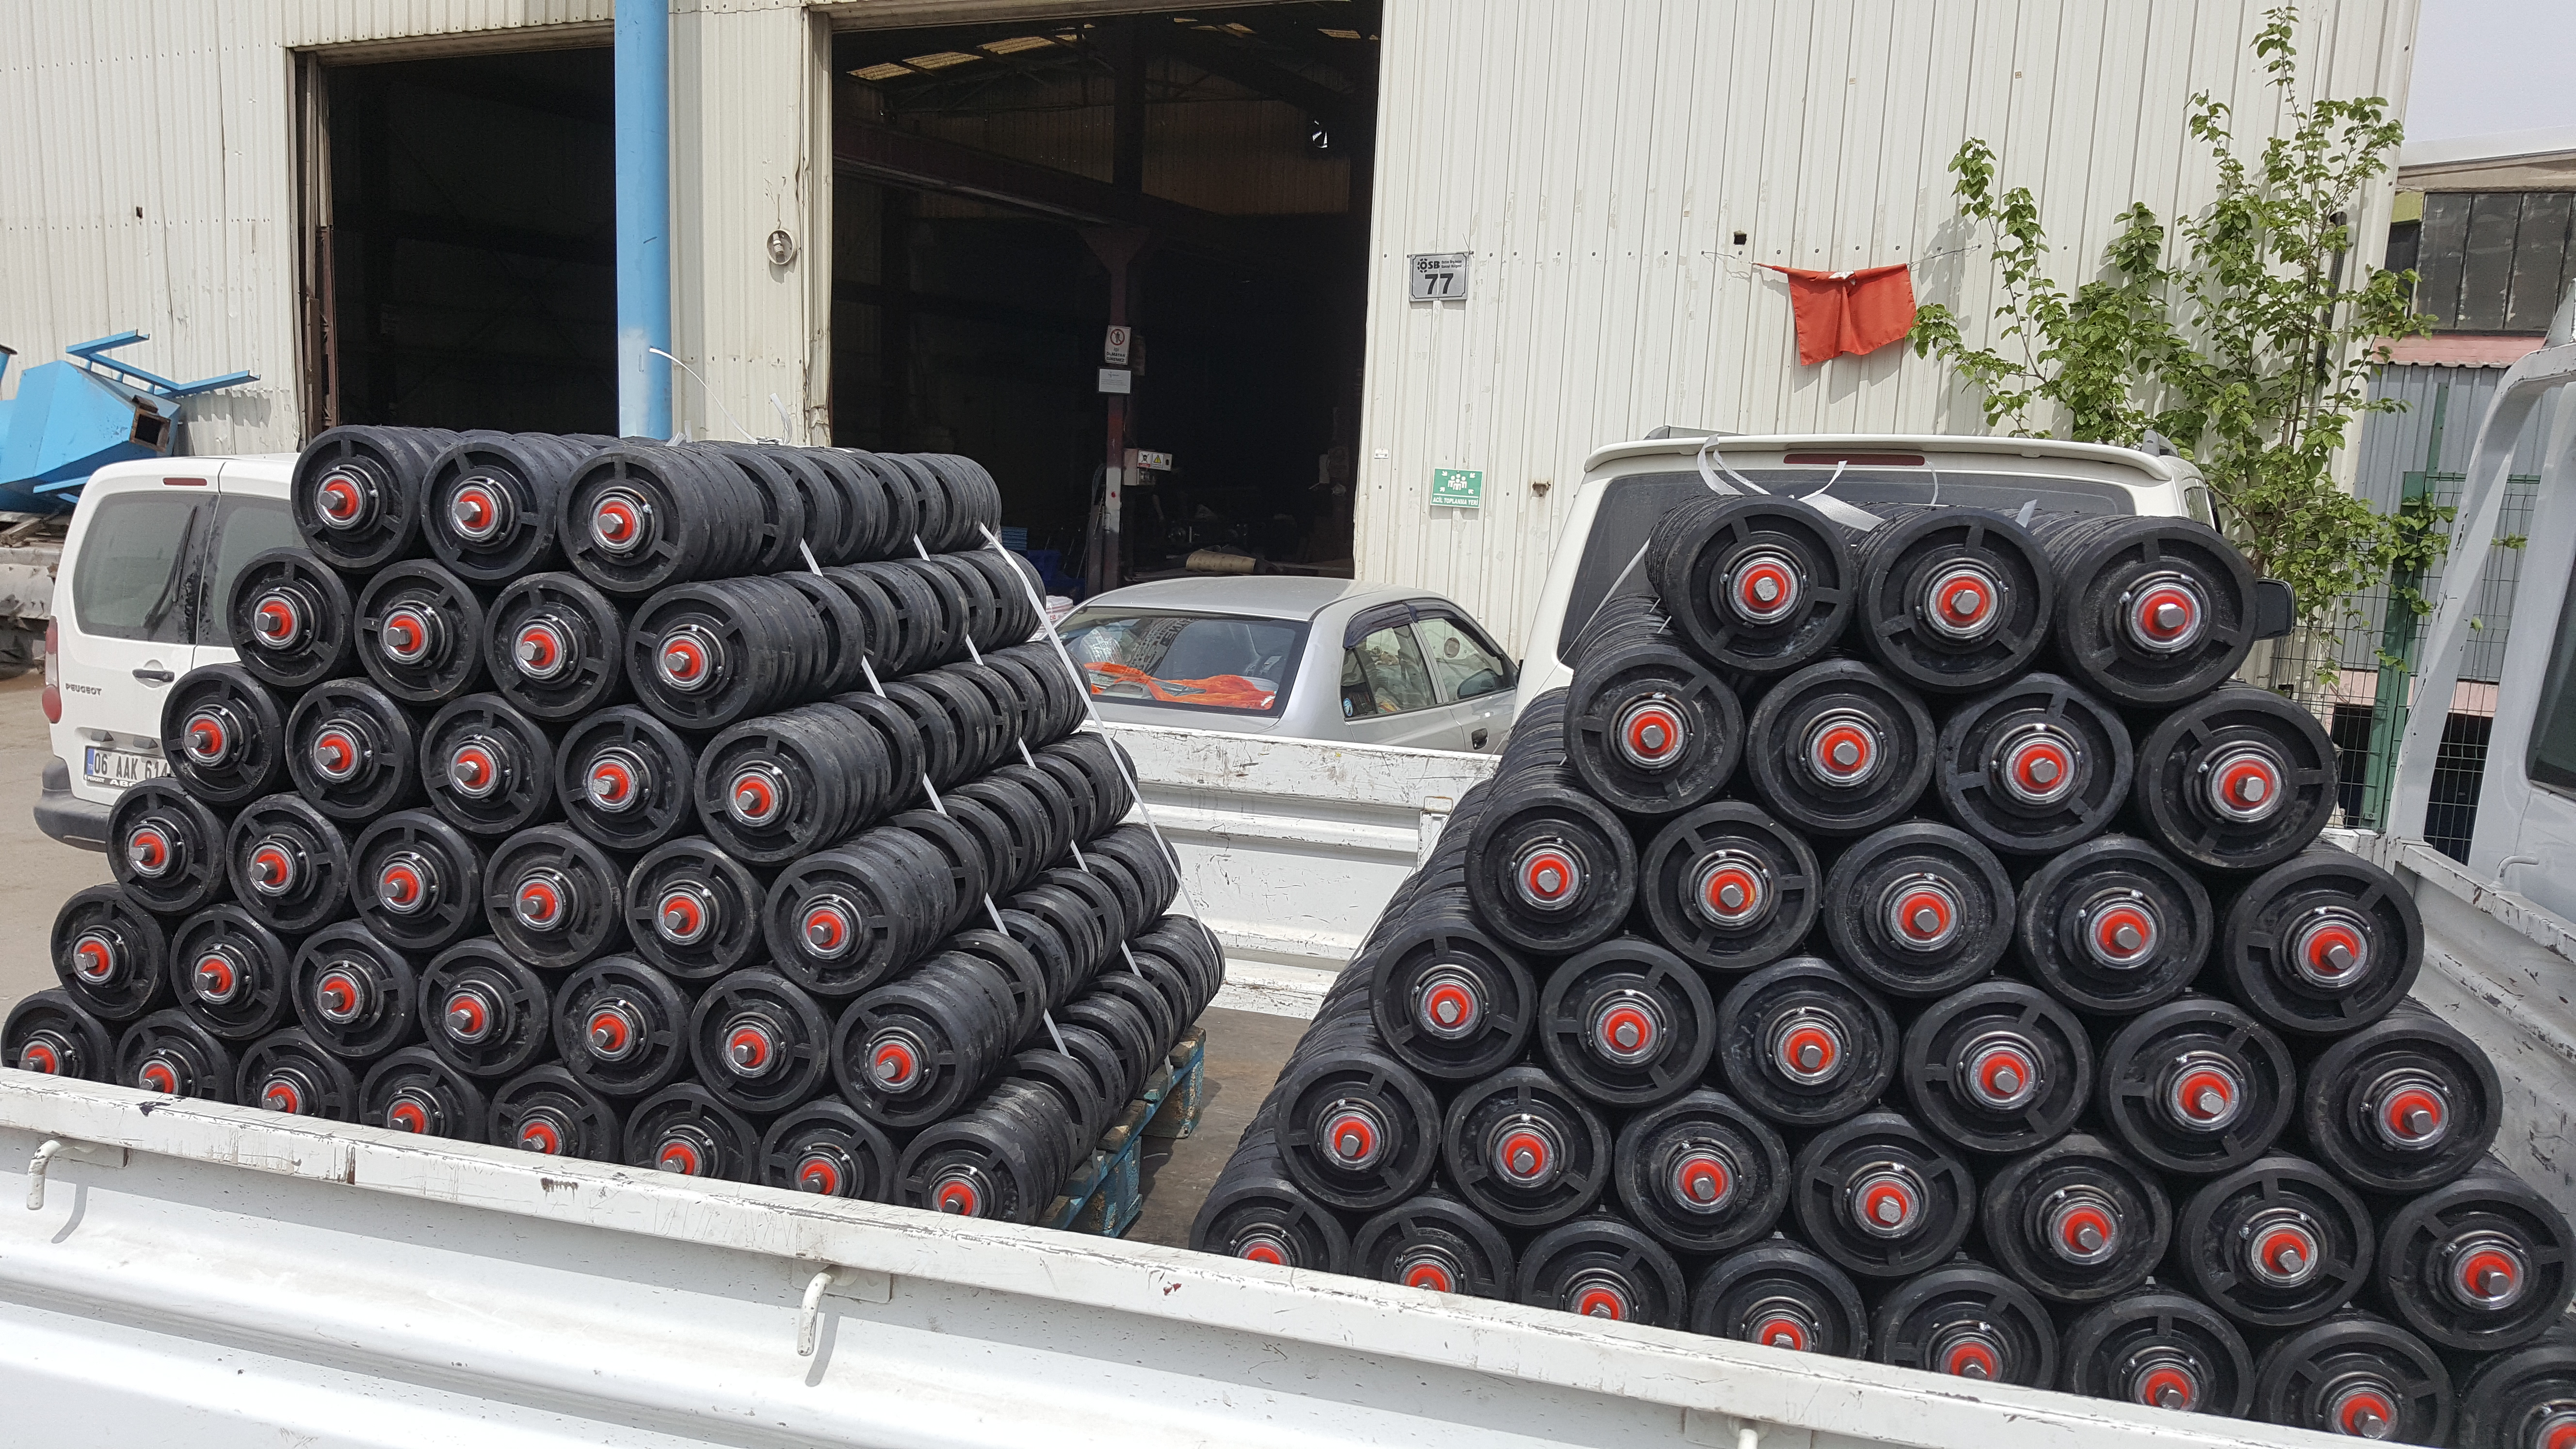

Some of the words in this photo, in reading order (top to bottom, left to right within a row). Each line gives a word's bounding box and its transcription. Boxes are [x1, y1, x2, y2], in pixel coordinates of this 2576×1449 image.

[1420, 260, 1440, 270] OSB
[1425, 273, 1453, 295] 77
[65, 683, 102, 696] PEUGEOT
[94, 753, 108, 775] 06
[116, 756, 138, 780] AAK
